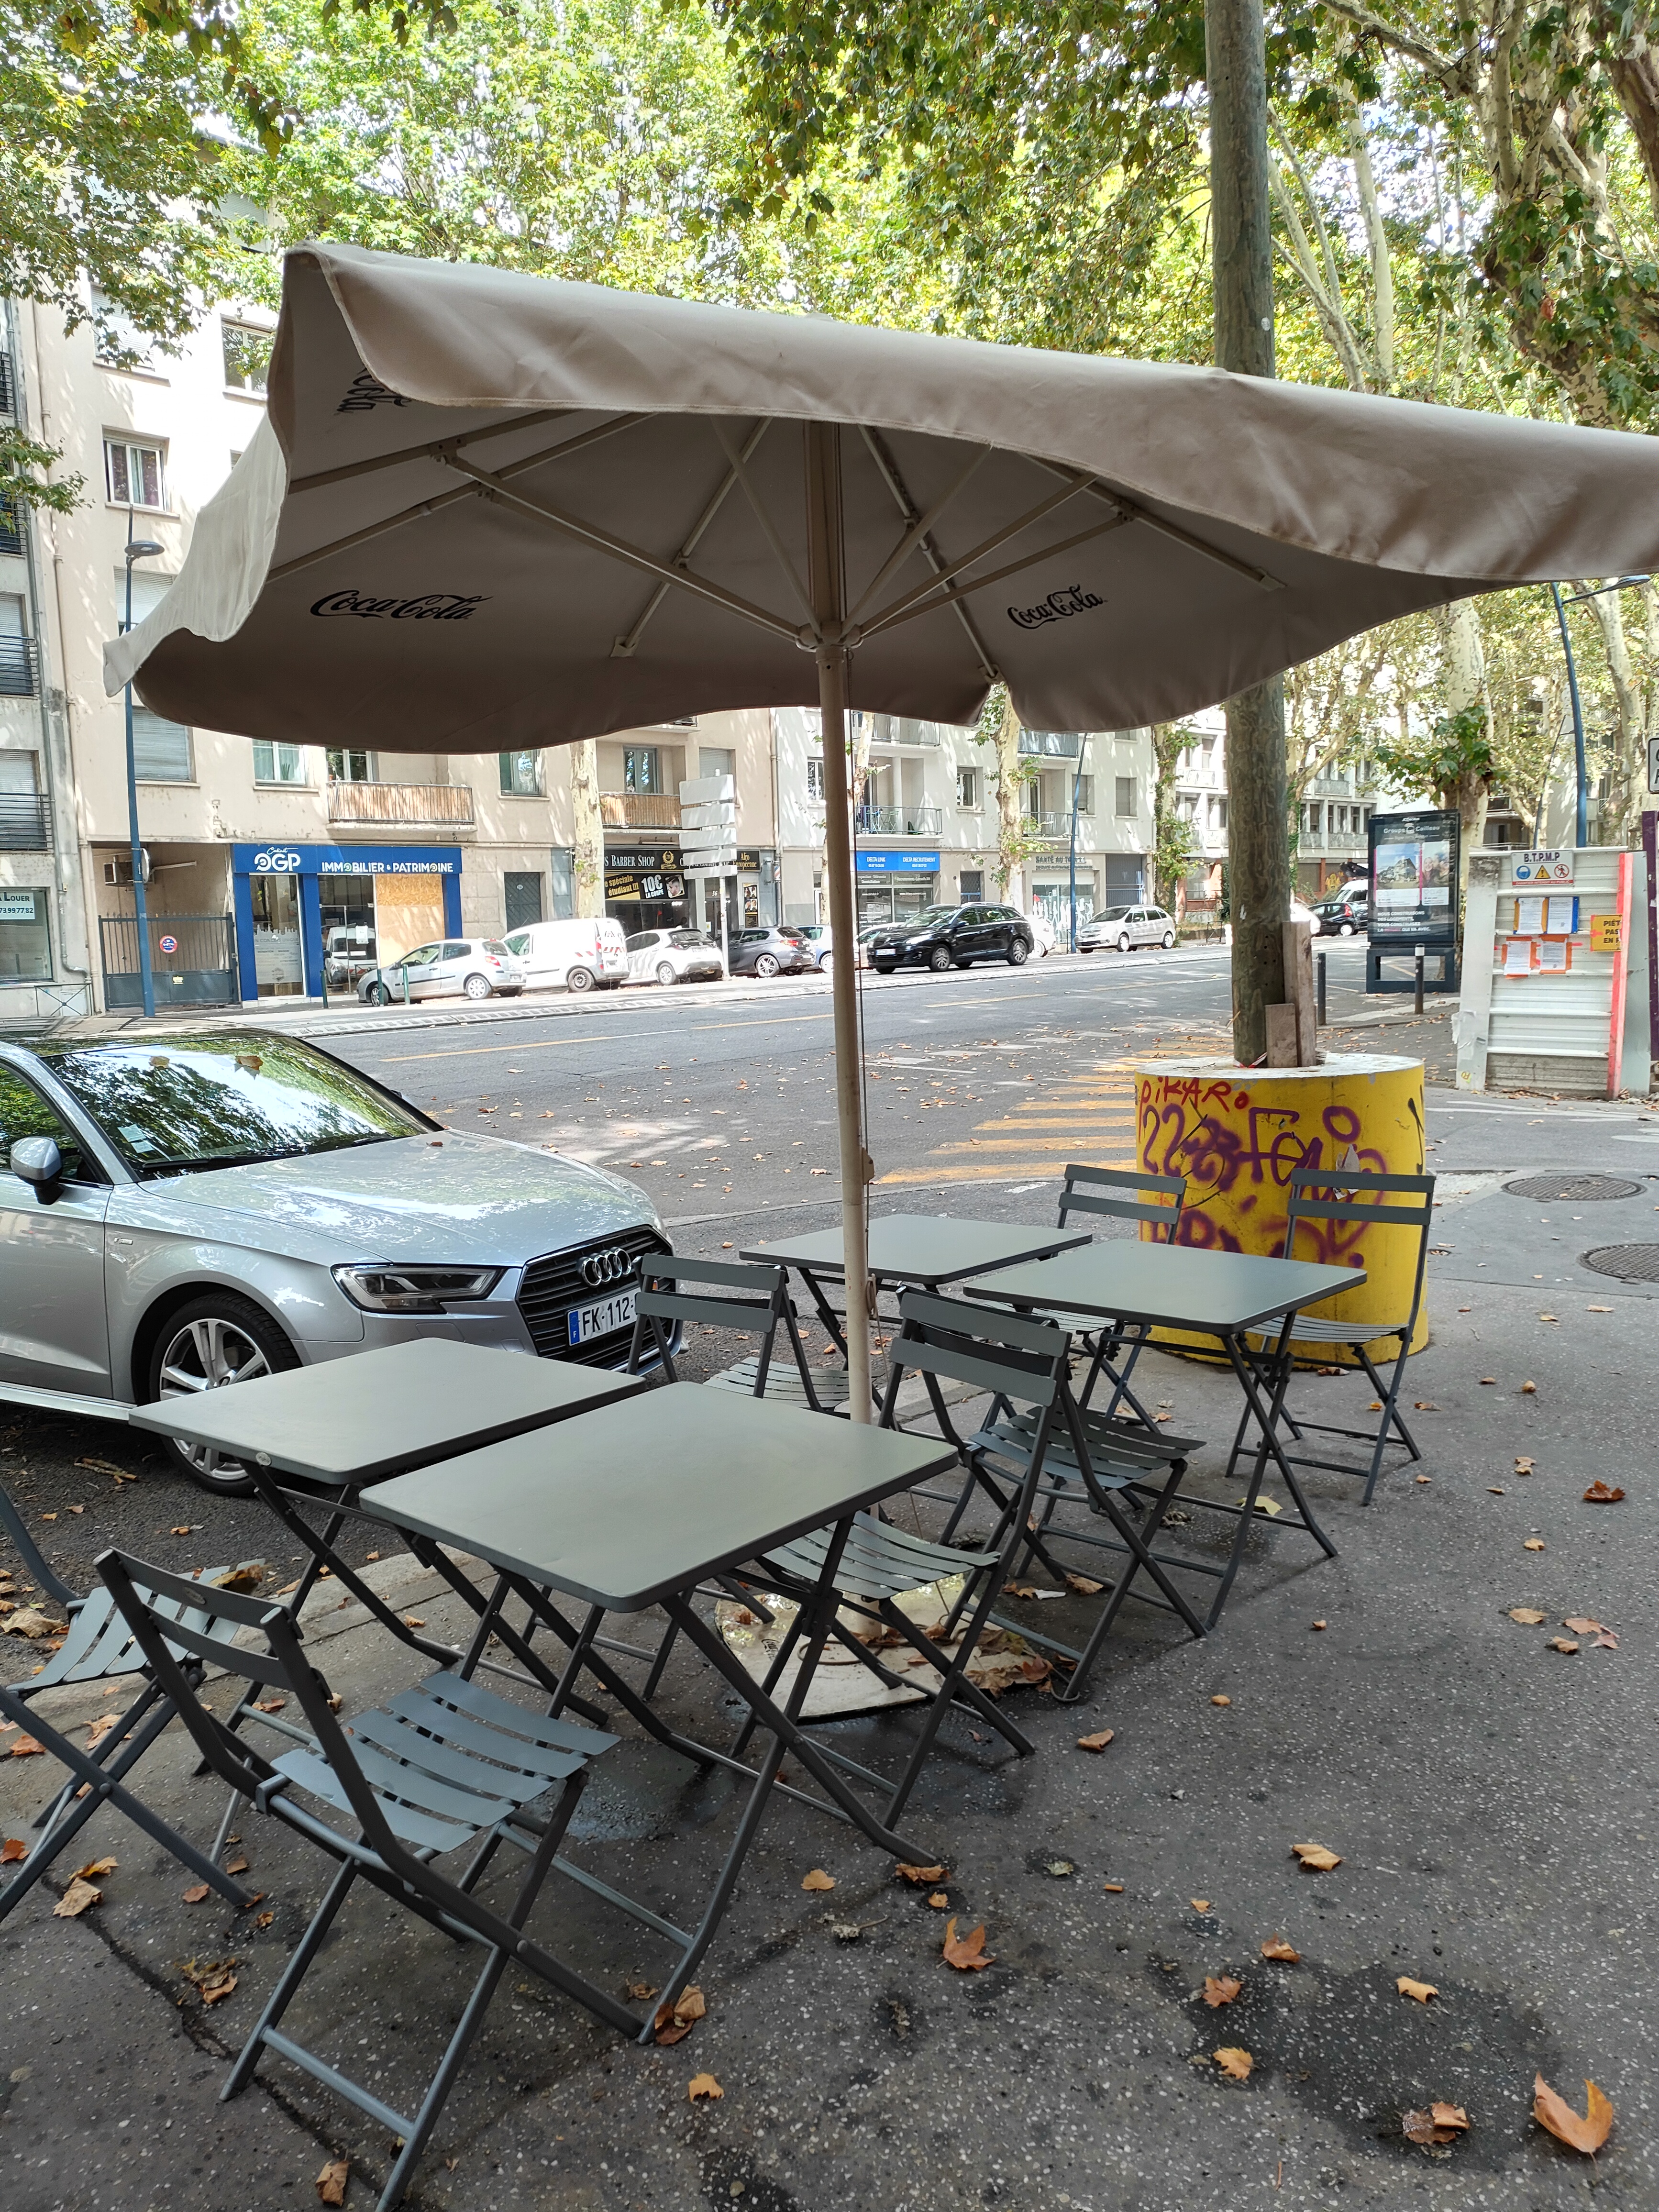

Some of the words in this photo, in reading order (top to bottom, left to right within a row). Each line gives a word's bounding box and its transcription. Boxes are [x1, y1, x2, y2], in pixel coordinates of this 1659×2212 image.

[310, 590, 494, 619] Coca-Cola
[1007, 584, 1103, 629] Coca-Cola
[741, 852, 750, 862] Afro
[1524, 852, 1560, 863] B.T.P.M.P
[321, 862, 385, 873] IMMOBILIER
[393, 862, 454, 873] PATRIMOINE
[608, 875, 634, 886] spéciale
[641, 874, 664, 893] 10€
[608, 884, 632, 896] étudiant
[651, 889, 664, 898] COUPE
[582, 1296, 638, 1336] FK-112-
